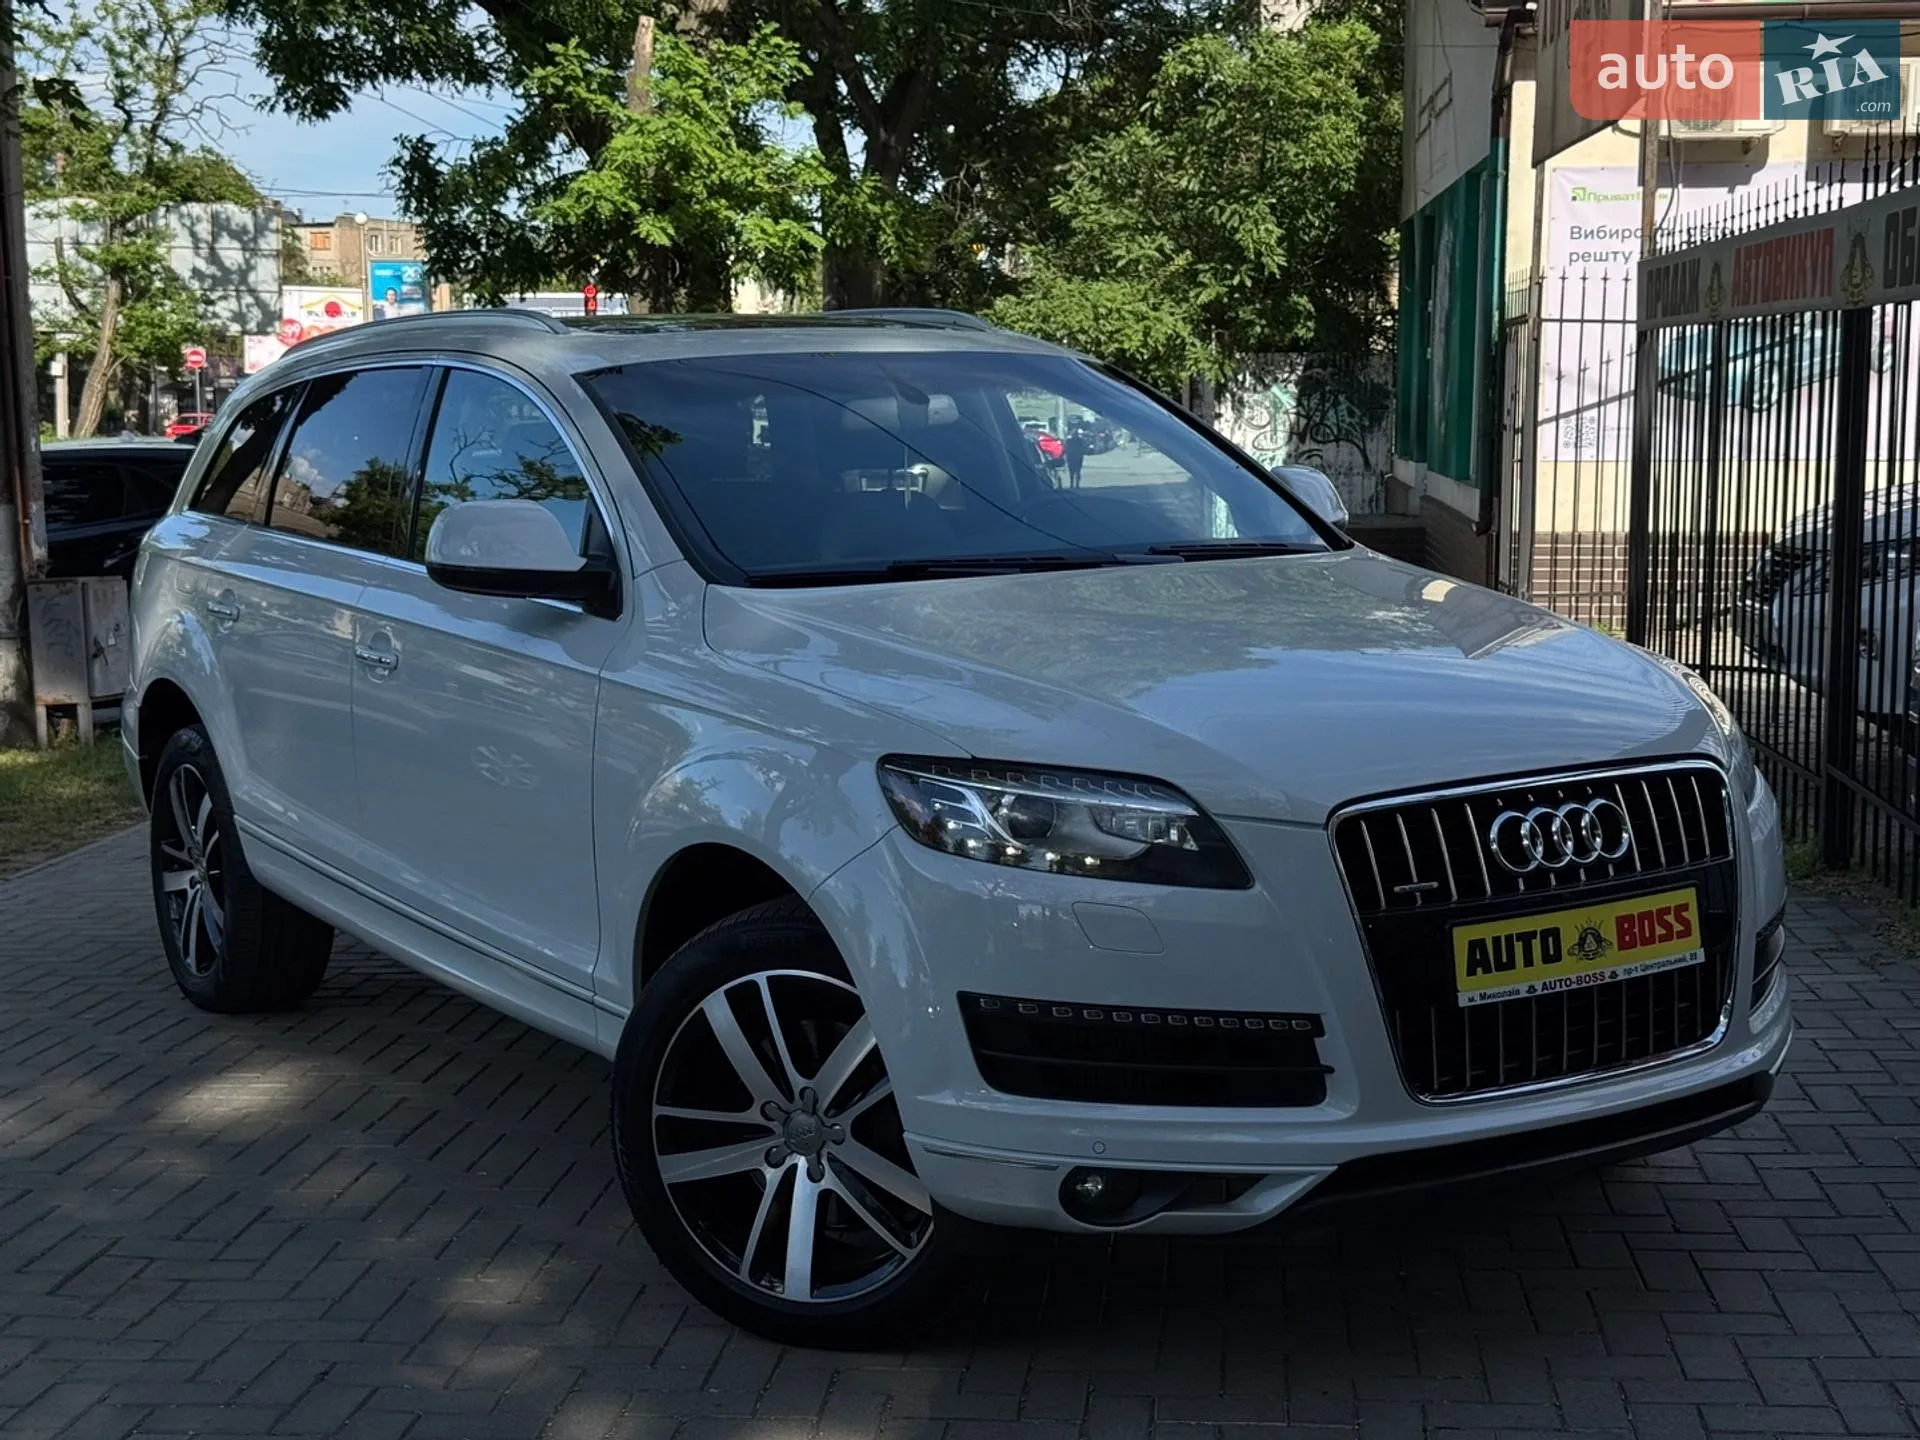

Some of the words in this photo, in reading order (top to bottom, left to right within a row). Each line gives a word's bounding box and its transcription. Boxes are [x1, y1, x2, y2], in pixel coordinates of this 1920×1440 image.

[1568, 251, 1633, 266] решту
[1646, 257, 1701, 321] ПРОДАЖ
[1732, 227, 1835, 308] АВТОВИКУП
[1883, 206, 1920, 290] ОБ
[1465, 926, 1563, 978] AUTO
[1614, 902, 1694, 952] BOSS
[1540, 971, 1606, 993] AUTO-BOSS
